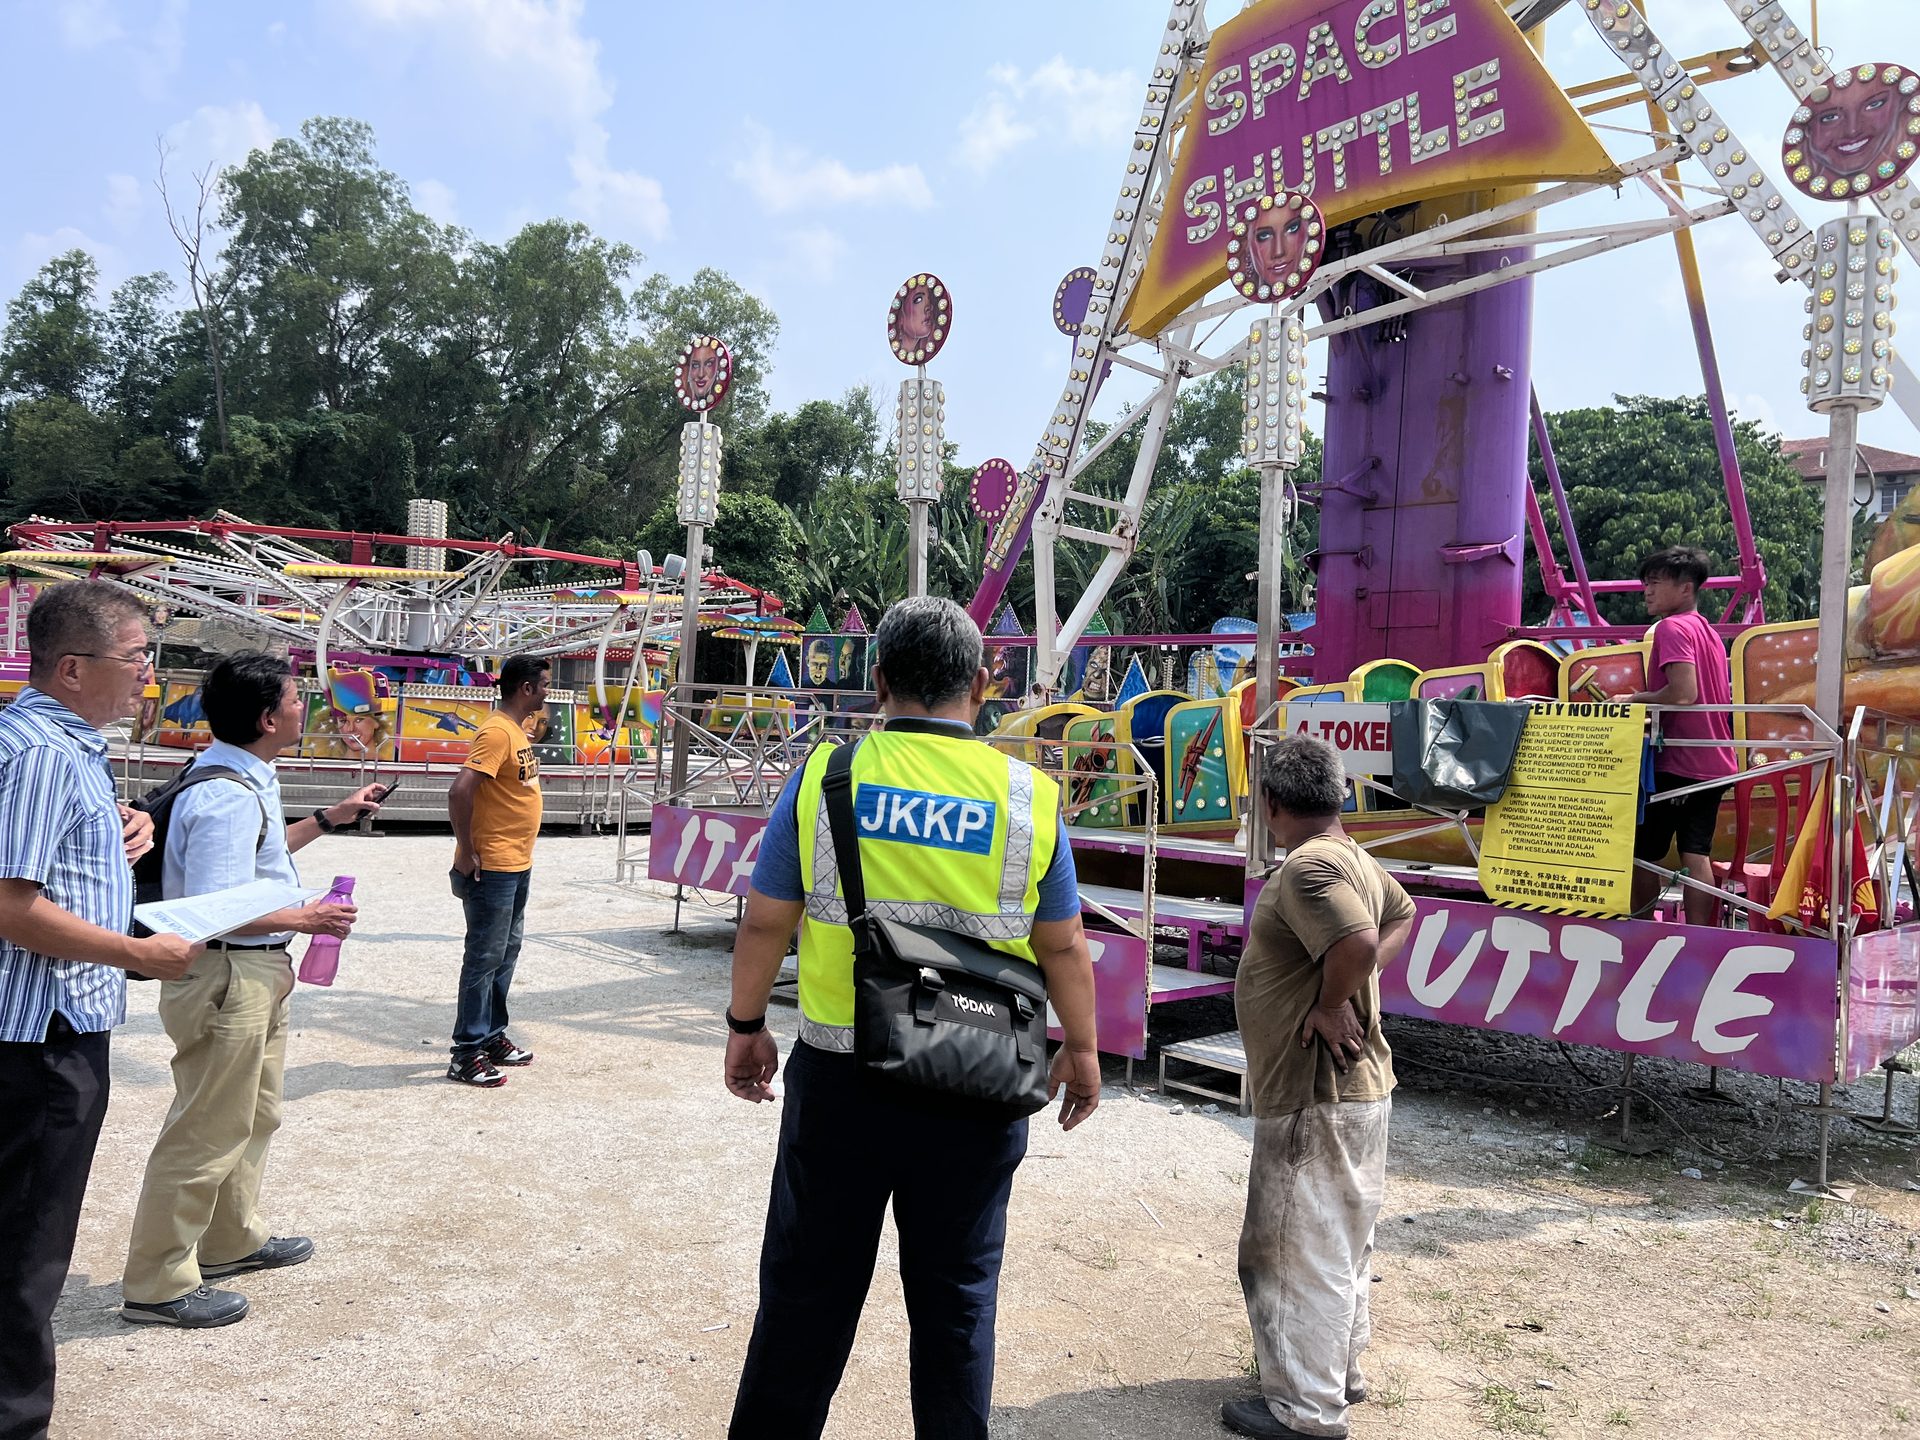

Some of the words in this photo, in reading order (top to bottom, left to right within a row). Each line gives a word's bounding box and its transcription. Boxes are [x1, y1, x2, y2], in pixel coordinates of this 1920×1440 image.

[1204, 0, 1458, 137] SPACE
[1184, 58, 1506, 244] SHUTTLE
[1567, 703, 1631, 719] NOTICE
[1521, 730, 1542, 738] ADIES,
[1543, 731, 1584, 739] CUSTOMERS
[1534, 738, 1571, 746] INFLUENCE
[1546, 746, 1573, 754] PEAPLE
[1592, 748, 1614, 756] WEAK
[1533, 760, 1585, 769] RECOMMENDED
[1577, 755, 1623, 764] DISPOSITION
[1526, 774, 1548, 782] GIVEN
[1511, 792, 1547, 800] PERMAINAN
[860, 792, 987, 843] JKKP
[1500, 814, 1532, 822] PENGARUH
[1534, 816, 1566, 826] ALKOHOL
[1502, 806, 1528, 814] INDIVIDU
[1530, 808, 1548, 816] YANG
[1550, 810, 1578, 818] BERADA
[1579, 813, 1613, 821] DIBAWAH
[1508, 822, 1544, 830] PENGHIDAP
[1568, 828, 1602, 836] JANTUNG
[1512, 837, 1553, 846] PERINGATAN
[1566, 842, 1594, 850] ADALAH
[1514, 830, 1545, 838] PENYAKIT
[1568, 835, 1610, 844] BERBAHAYA
[1524, 846, 1574, 856] KESELAMATAN
[1407, 909, 1795, 1054] UTTLE
[952, 994, 996, 1017] TODAK
